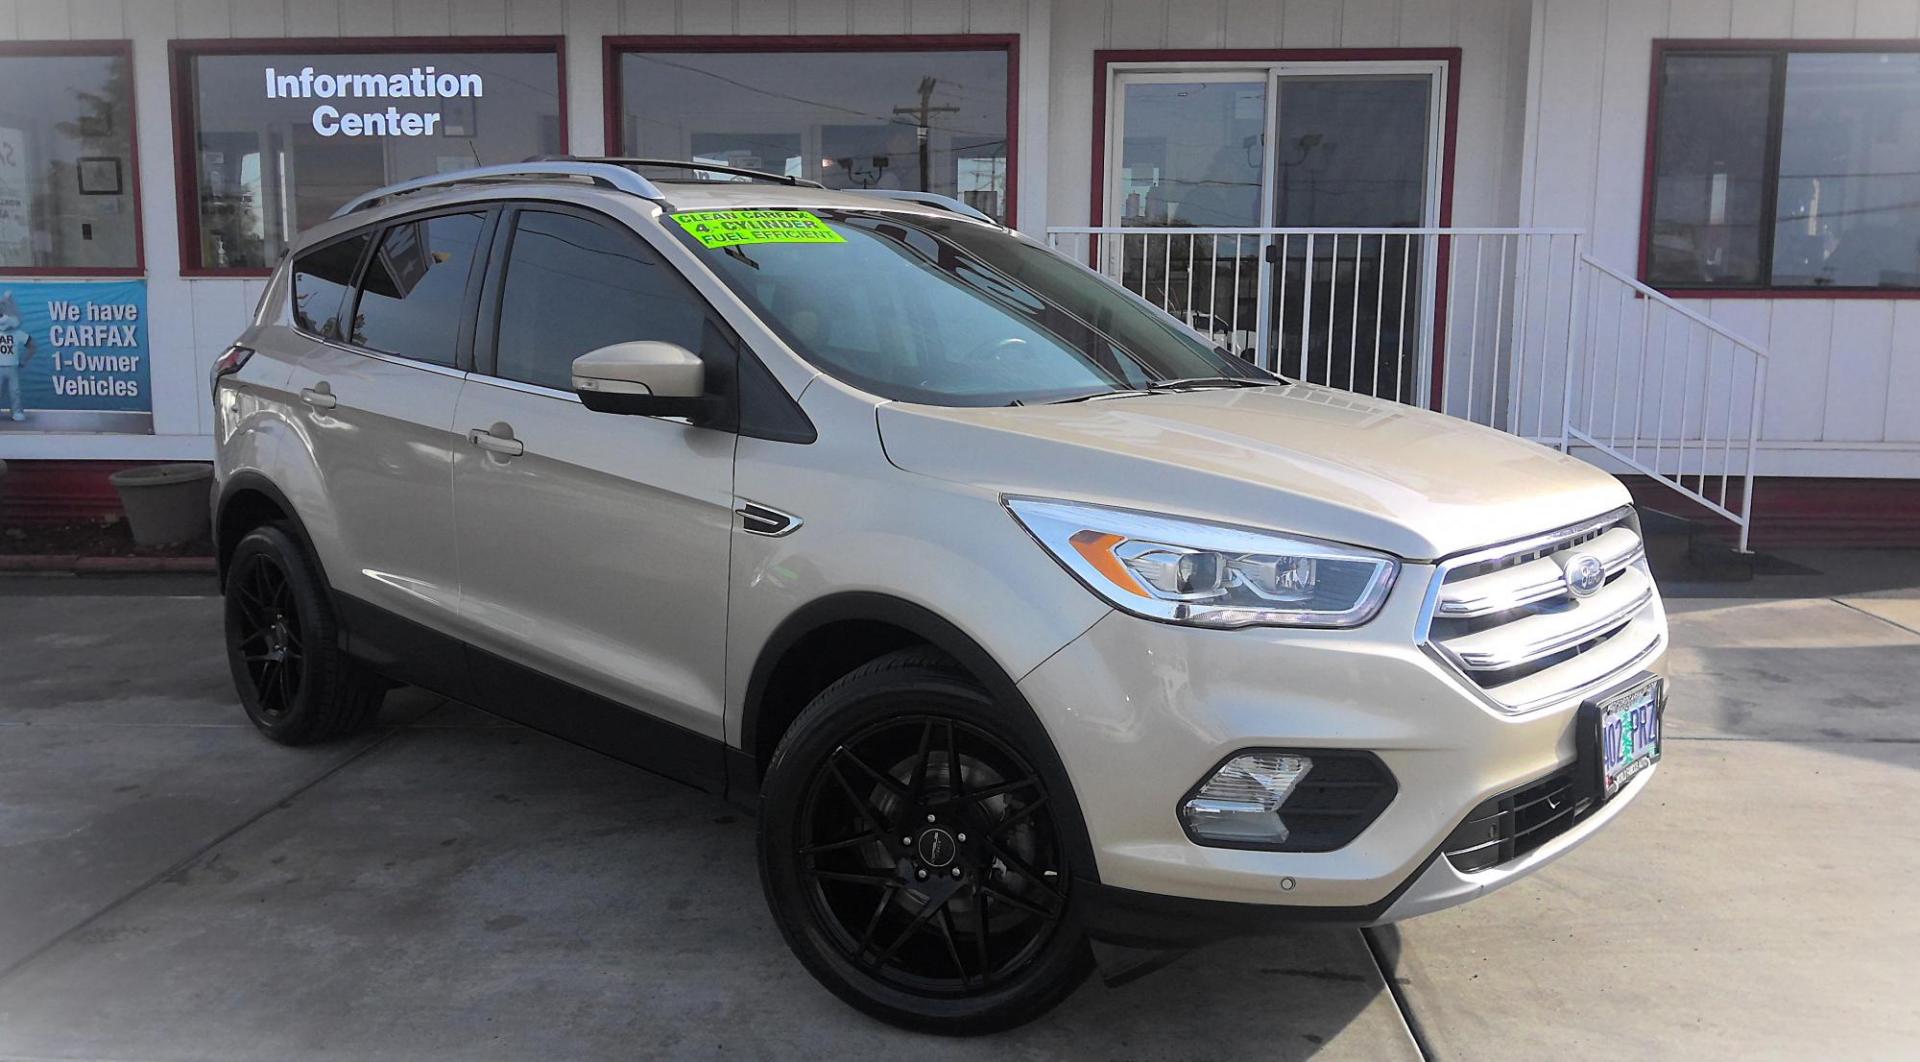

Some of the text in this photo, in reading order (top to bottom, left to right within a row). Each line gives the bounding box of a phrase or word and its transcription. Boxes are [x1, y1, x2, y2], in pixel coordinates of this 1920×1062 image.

[265, 66, 483, 99] Information
[312, 104, 441, 137] Center
[678, 211, 809, 224] CLEAN CARFAX
[701, 230, 834, 244] FUEL EFFICIENT
[48, 300, 138, 322] We have
[49, 324, 138, 348] CARFAX
[52, 350, 140, 373] 1-Owner
[52, 375, 139, 397] Vehicles
[1631, 699, 1656, 754] PRZ
